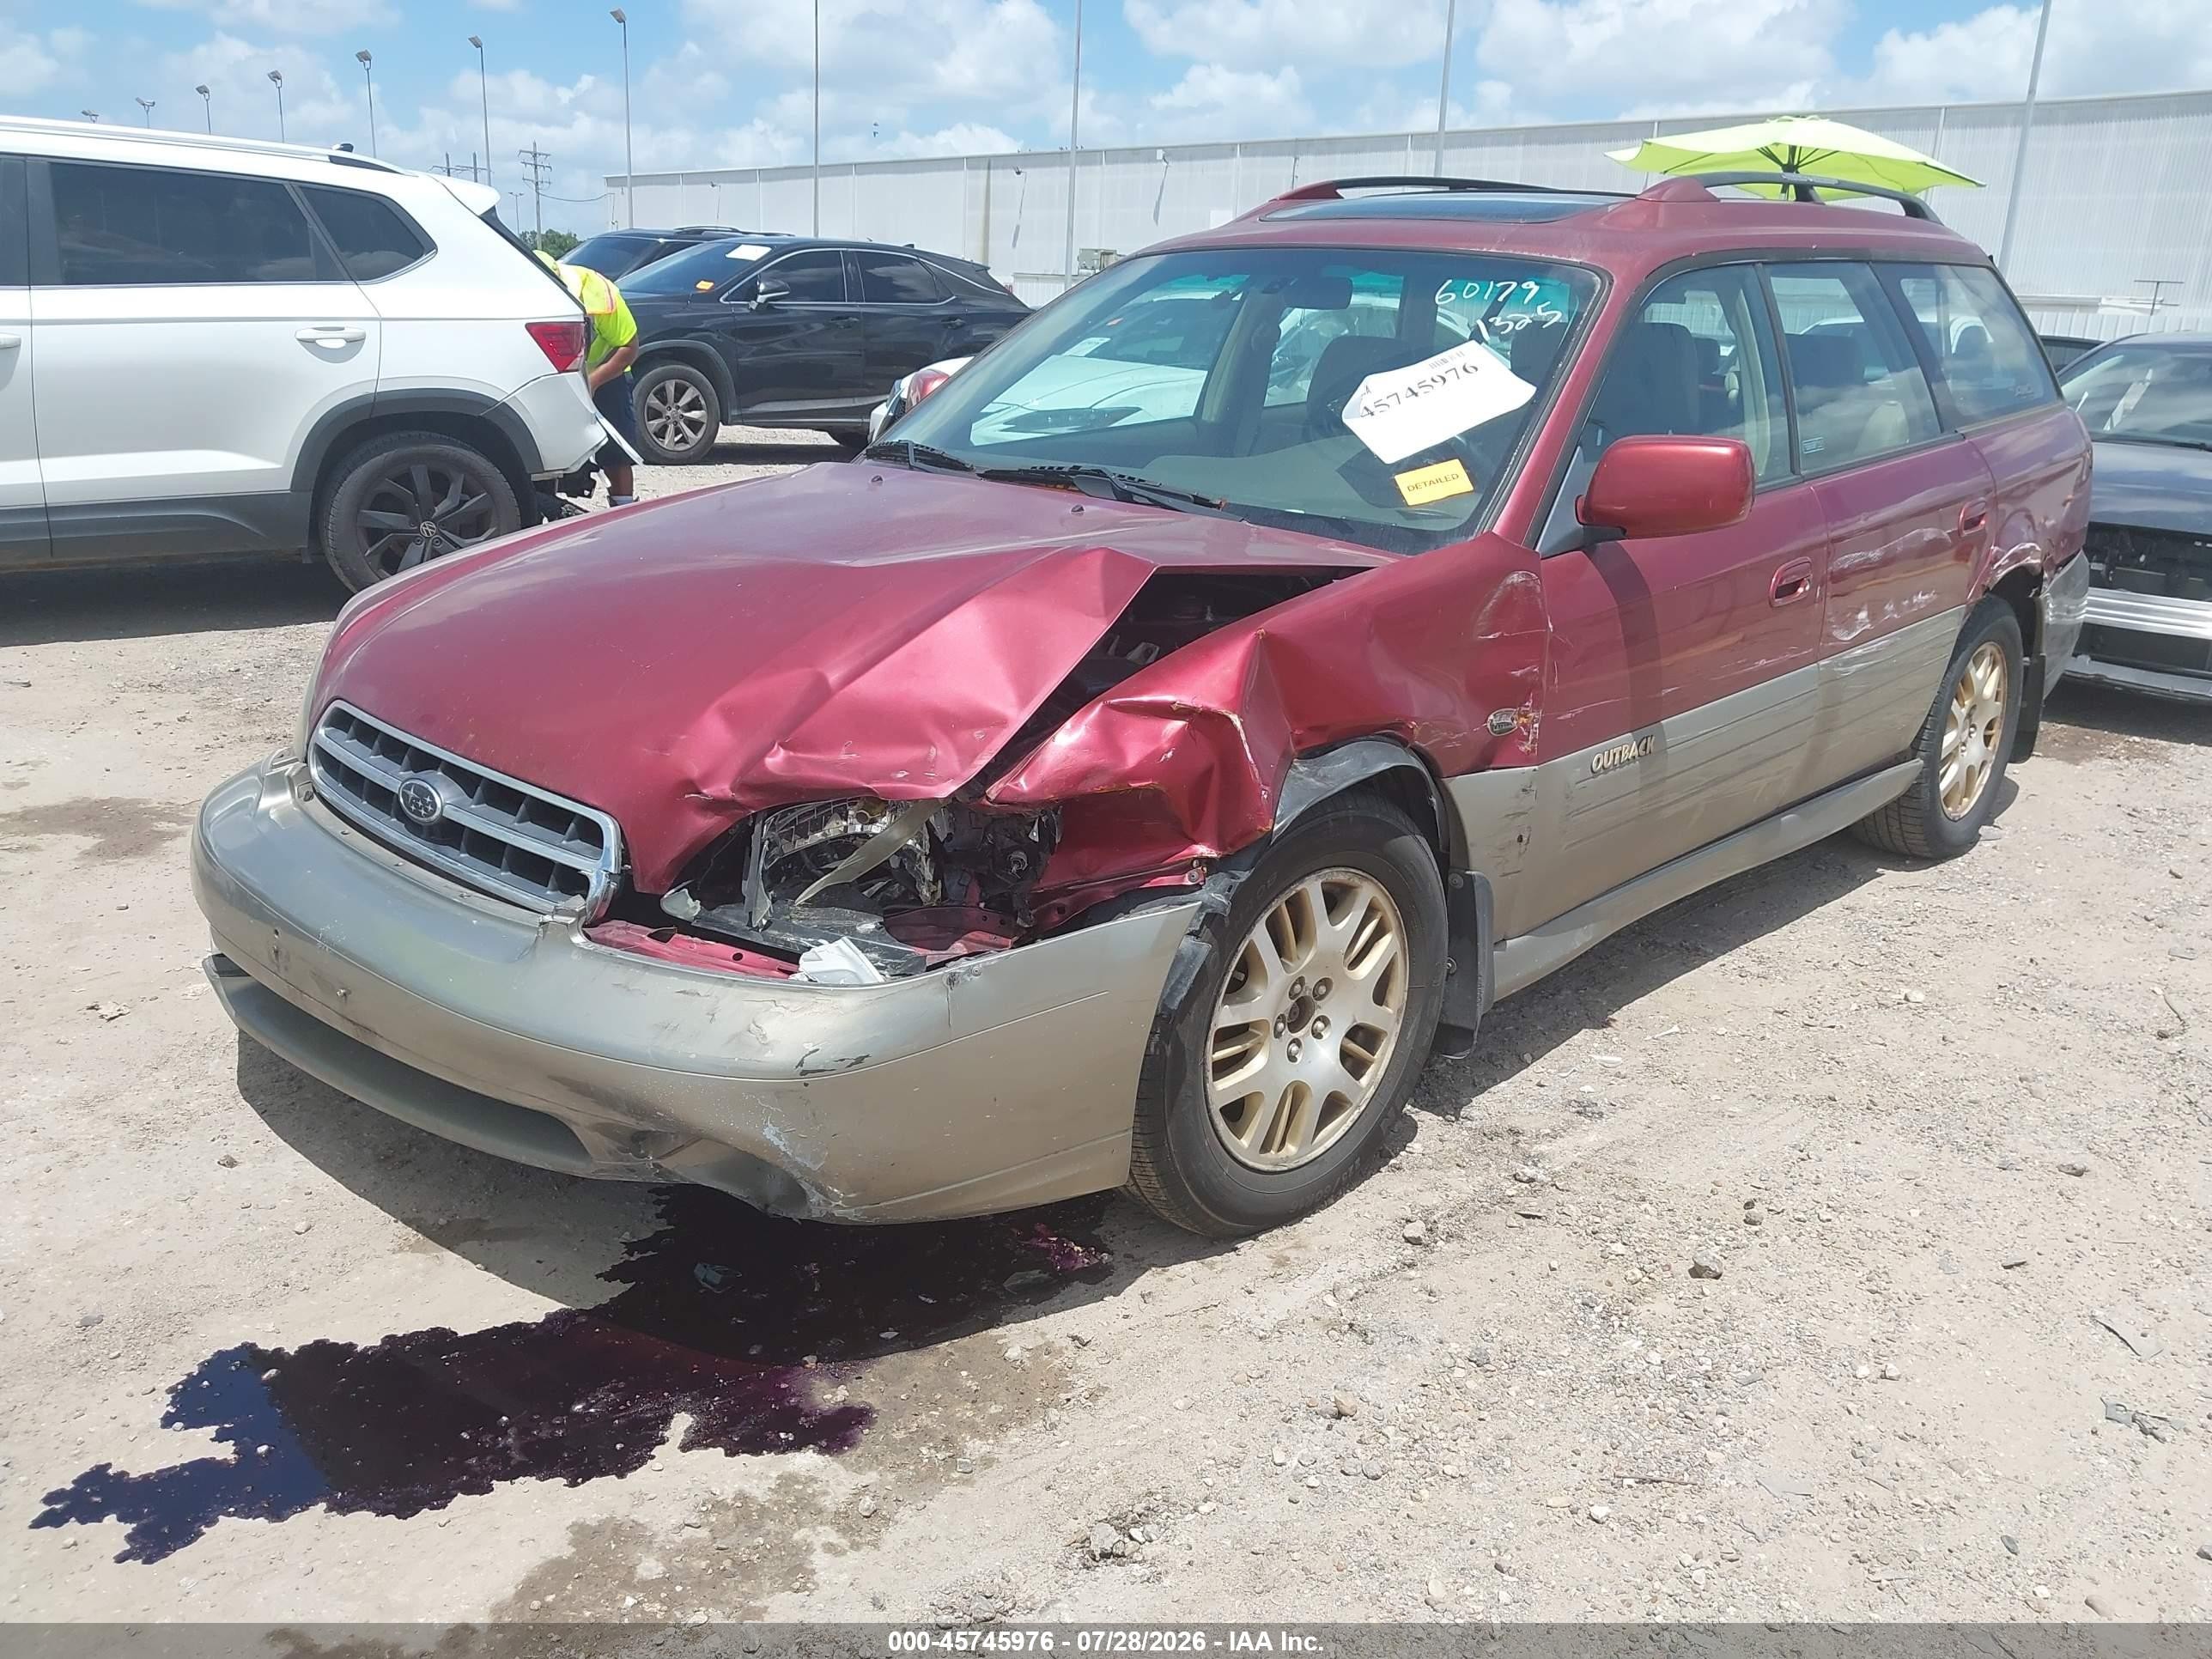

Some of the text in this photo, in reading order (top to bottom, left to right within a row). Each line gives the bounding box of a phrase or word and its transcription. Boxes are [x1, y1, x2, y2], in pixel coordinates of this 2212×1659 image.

[1435, 279, 1540, 305] 60179
[1359, 362, 1479, 418] 45745976
[1407, 473, 1459, 492] DETAILED
[1591, 735, 1656, 774] OUTBACK
